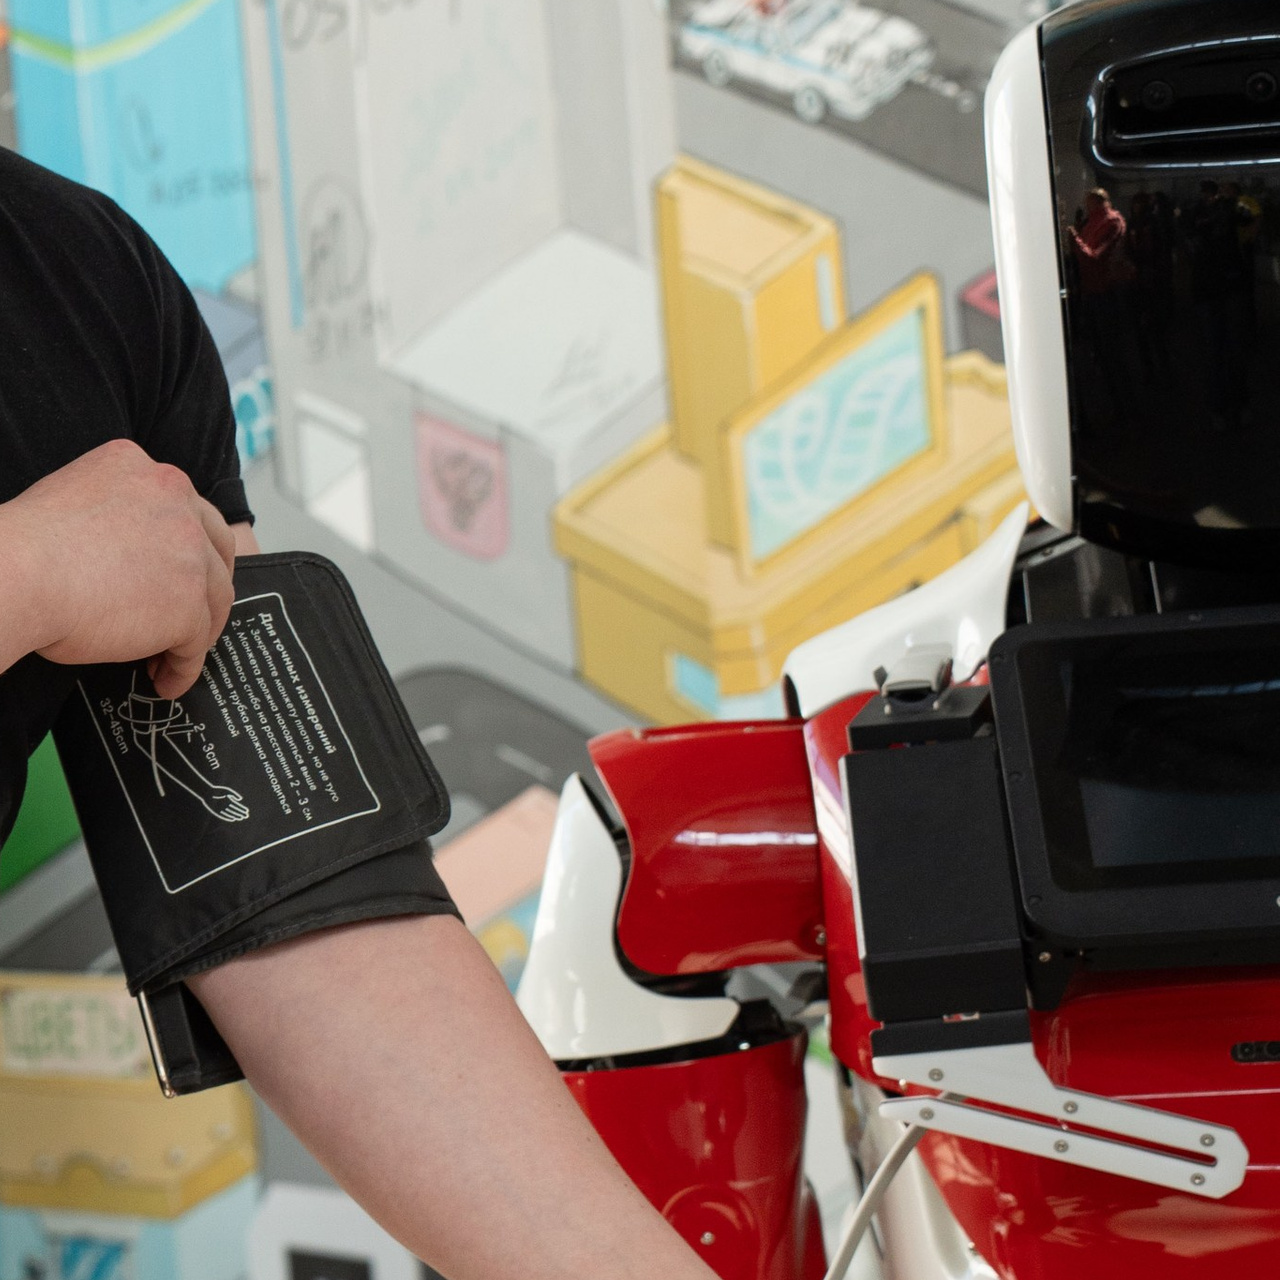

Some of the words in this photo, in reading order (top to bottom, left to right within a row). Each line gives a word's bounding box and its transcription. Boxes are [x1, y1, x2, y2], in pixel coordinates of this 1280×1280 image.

[230, 618, 242, 631] 2.
[245, 616, 256, 627] 1.
[220, 634, 247, 683] локтевого
[235, 631, 261, 676] Манжета
[249, 627, 279, 677] Закрепите
[242, 682, 261, 711] сгиба
[254, 676, 279, 712] должна
[257, 611, 277, 637] Для
[271, 637, 301, 684] точных
[294, 684, 337, 754] измерений
[273, 677, 299, 718] манжету
[206, 643, 234, 689] езиновая
[227, 689, 250, 724] трубка
[242, 723, 267, 760] должна
[261, 759, 292, 815] находиться
[219, 706, 240, 738] ямкой
[255, 710, 268, 725] на
[273, 711, 305, 765] находиться
[293, 718, 315, 754] плотно,
[259, 724, 294, 779] расстоянии
[311, 754, 323, 769] но
[288, 778, 301, 788] 2
[299, 764, 317, 791] выше
[317, 768, 329, 781] не
[297, 796, 309, 806] 3
[323, 781, 339, 803] туго
[301, 806, 313, 821] см
